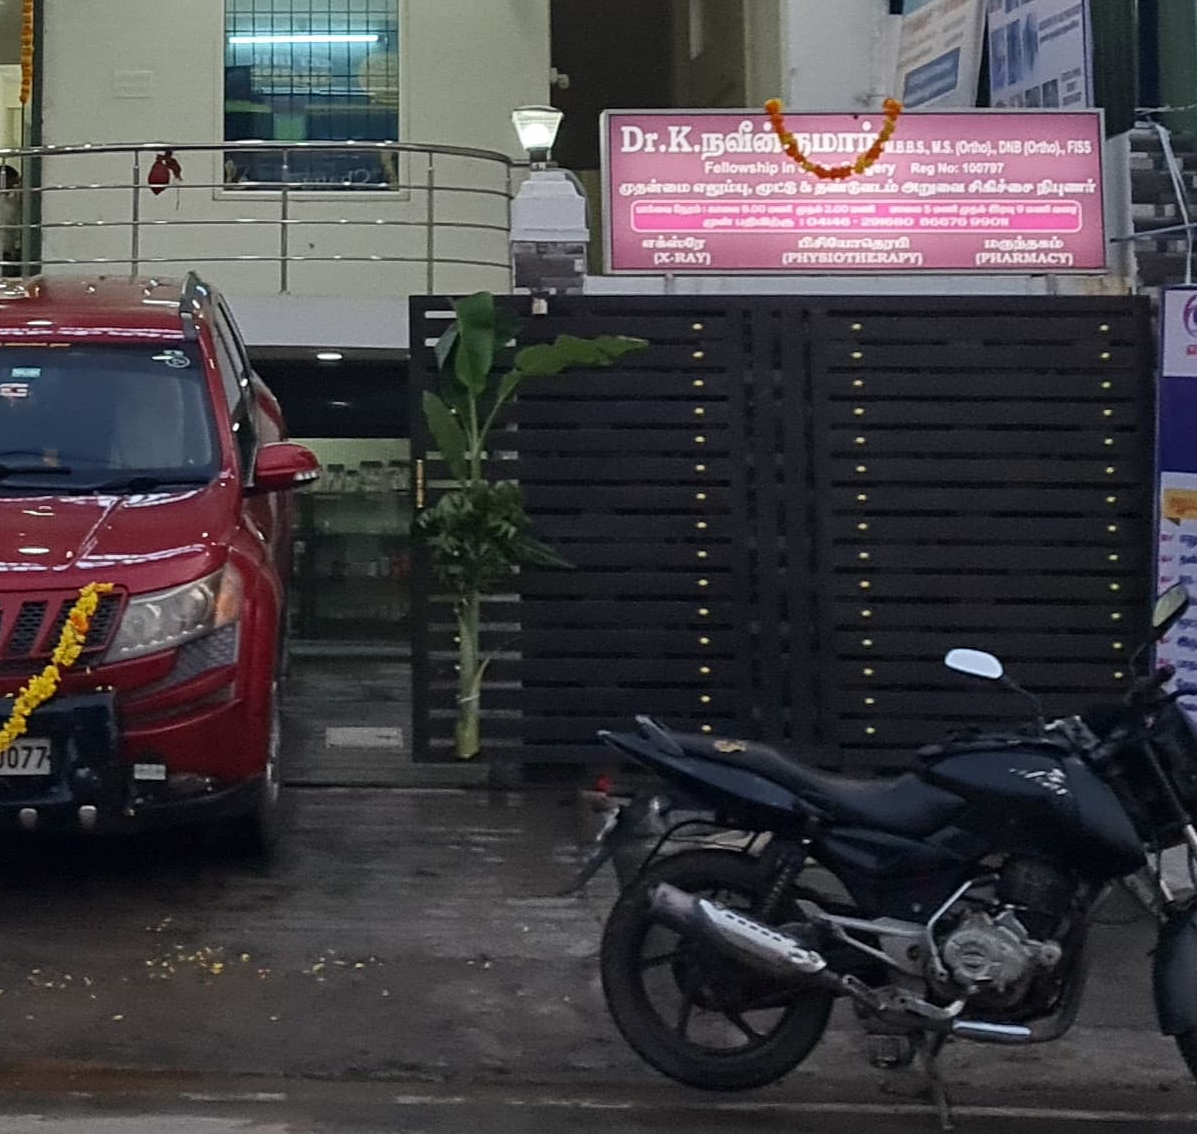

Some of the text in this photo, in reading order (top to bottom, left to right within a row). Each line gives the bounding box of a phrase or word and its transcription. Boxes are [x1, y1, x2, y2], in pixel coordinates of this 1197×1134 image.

[1067, 140, 1092, 154] FISS
[704, 161, 778, 176] Fellowship
[910, 162, 936, 176] Reg
[619, 178, 691, 197] முதன்மை
[800, 181, 813, 194] &
[901, 180, 965, 196] அறுவை
[968, 178, 1034, 195] சிகிச்சை
[1037, 177, 1097, 196] நிபுணர்
[654, 251, 711, 266] (X-RAY)
[781, 251, 923, 266] (PHYSIOTHERAPY)
[975, 252, 1074, 266] (PHARMACY)
